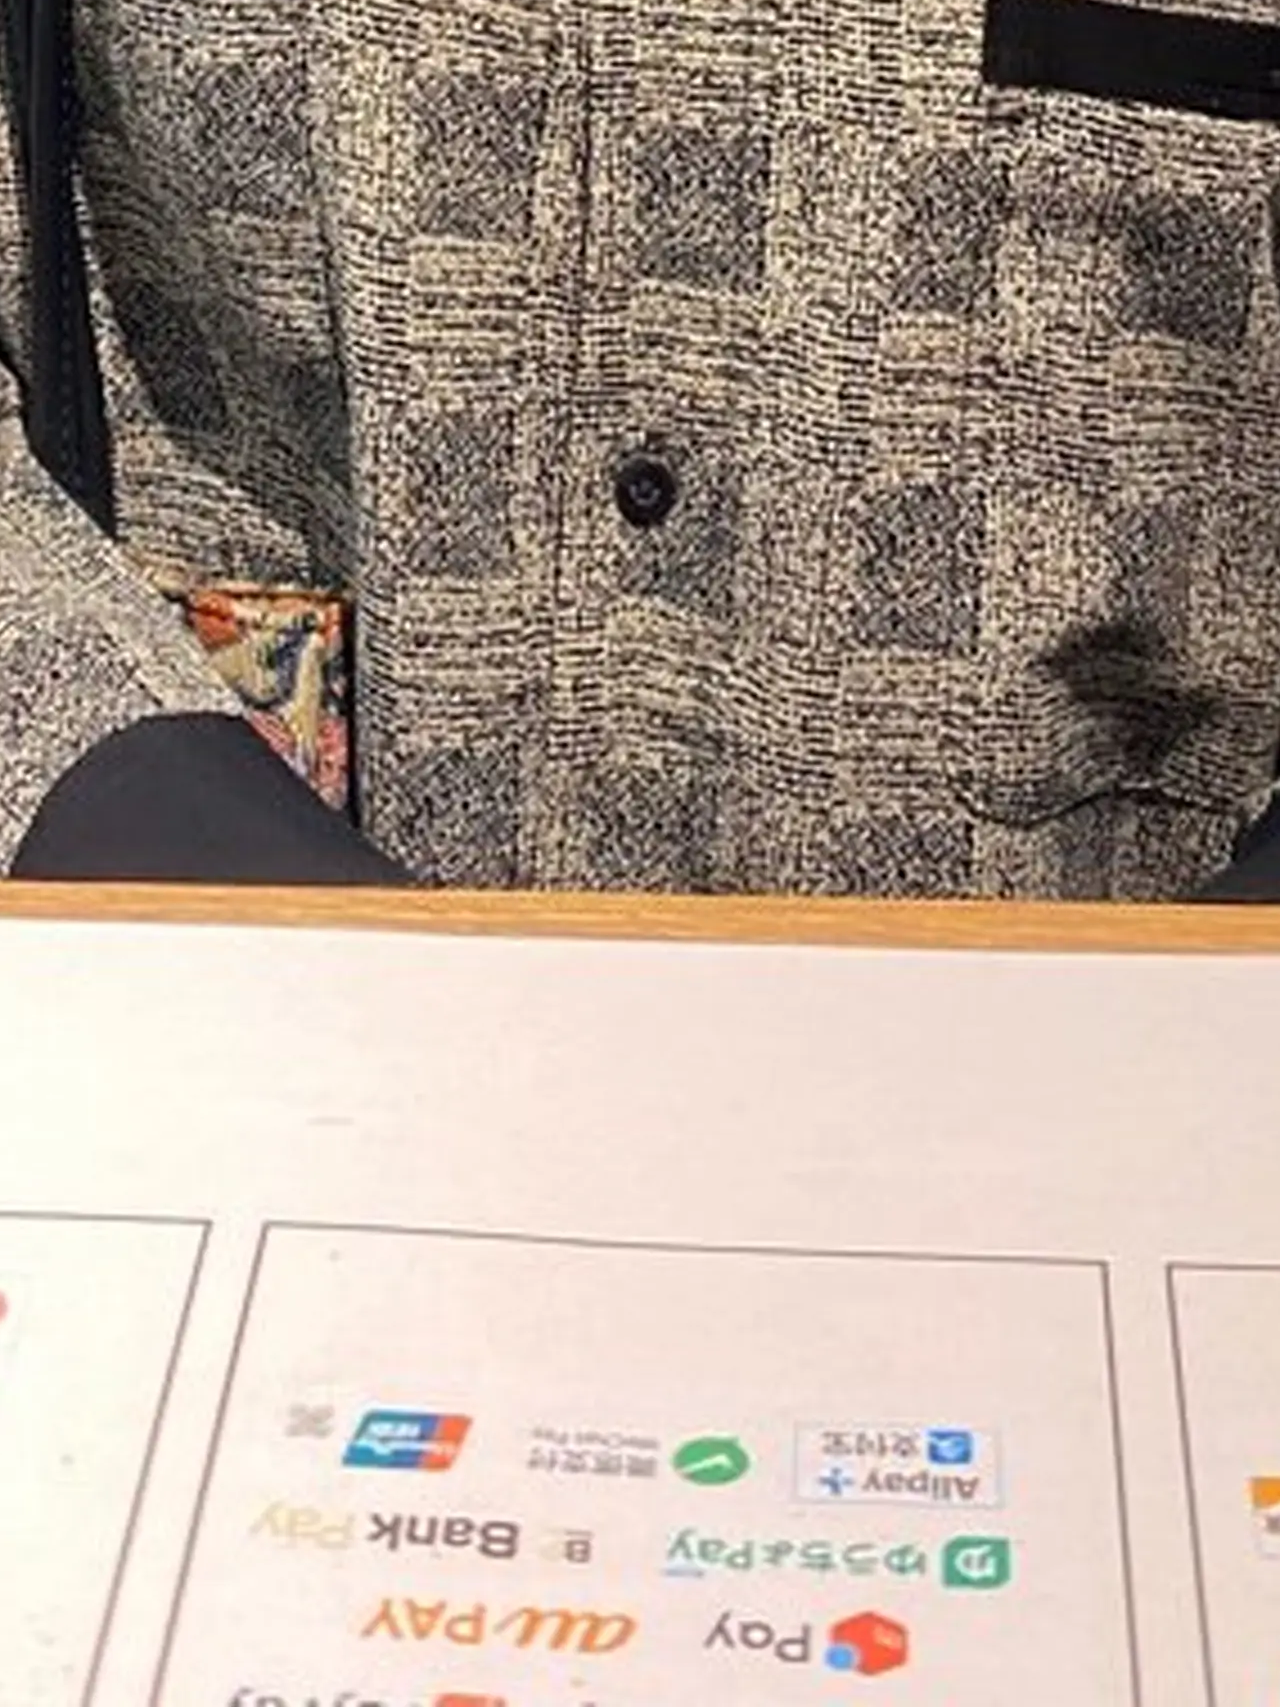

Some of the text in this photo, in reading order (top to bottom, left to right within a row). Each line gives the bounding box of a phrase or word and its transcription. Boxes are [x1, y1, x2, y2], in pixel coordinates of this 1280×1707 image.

[247, 1500, 356, 1551] Pay
[365, 1512, 520, 1560] Bank
[359, 1598, 638, 1656] au PAY
[702, 1610, 812, 1664] Pay
